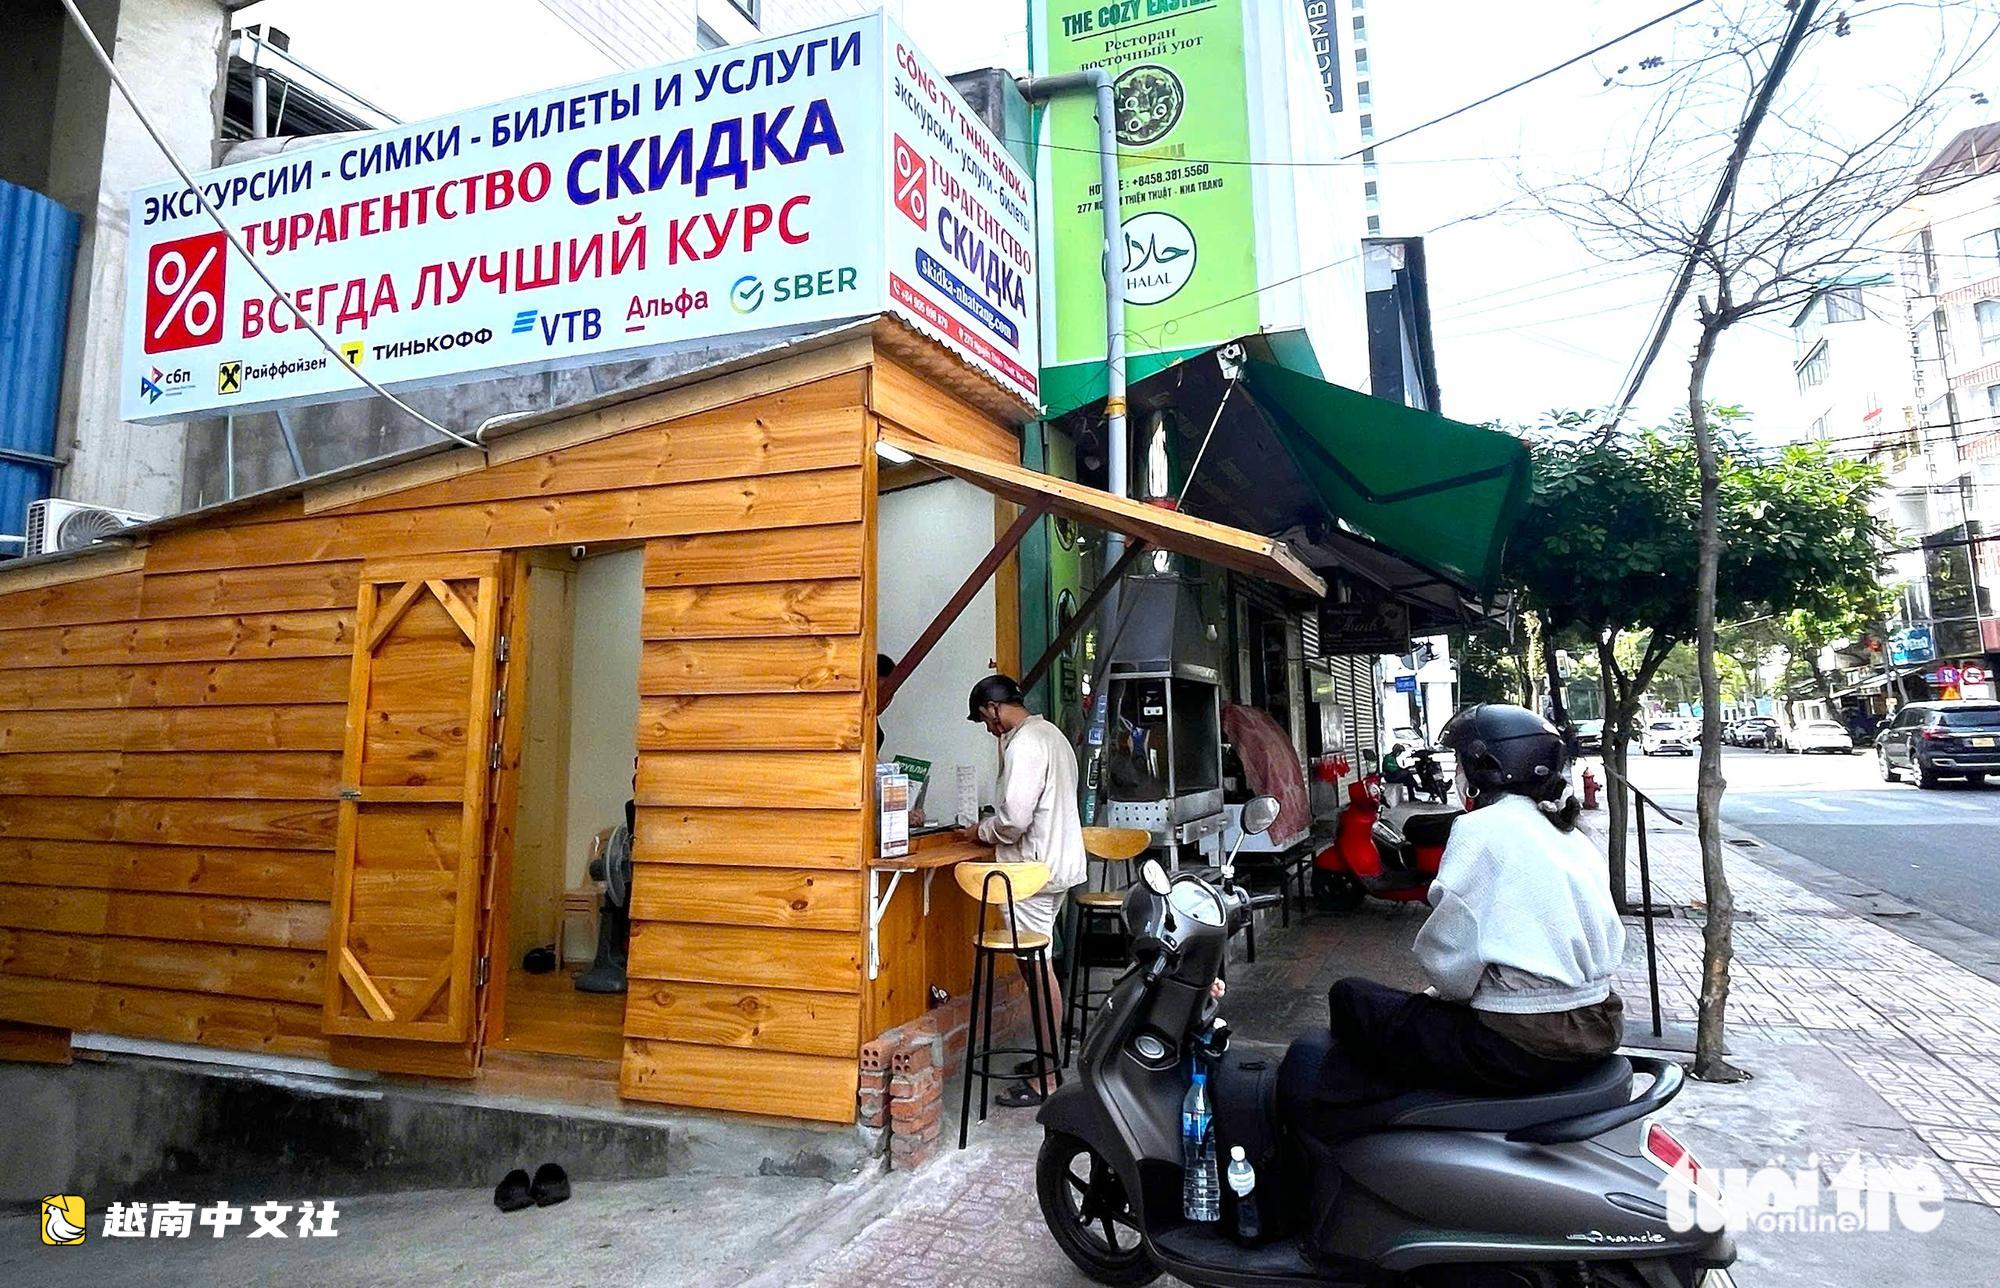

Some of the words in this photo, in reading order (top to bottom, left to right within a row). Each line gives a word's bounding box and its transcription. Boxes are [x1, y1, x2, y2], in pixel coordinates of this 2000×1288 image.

[1062, 11, 1093, 36] THE
[1098, 0, 1140, 27] COZY
[1079, 41, 1167, 71] восточный
[1171, 36, 1204, 55] уют
[1104, 27, 1176, 52] Ресторан
[143, 162, 313, 225] ЭКСКУРСИИ
[340, 126, 460, 194] СИМКИ
[492, 83, 640, 147] БИЛЕТЫ
[655, 73, 682, 111] И
[695, 31, 861, 102] УСЛУГИ
[897, 43, 937, 104] CÔNG
[940, 91, 956, 123] TY
[959, 112, 990, 163] TNHH
[992, 151, 1028, 207] SKIDKA
[241, 162, 551, 257] ТУРАГЕНТСТВО
[566, 98, 844, 205] СКИДКА
[961, 149, 993, 194] услуги
[1000, 186, 1030, 234] билеты
[1132, 163, 1209, 187] +8458.381.5560
[1077, 202, 1092, 214] 277
[1180, 182, 1196, 194] NHA
[1198, 178, 1224, 191] TRANG
[929, 155, 1031, 275] ТУРАГЕНТСТВО
[242, 273, 399, 339] ВСЕГДА
[411, 212, 647, 311] ЛУЧШИЙ
[668, 195, 811, 265] КУРС
[938, 206, 1027, 319] СКИДКА
[774, 266, 858, 303] SBER
[921, 257, 1012, 340] skidka-nhatrang.com
[1127, 272, 1172, 290] HALAL
[626, 288, 709, 321] Альфа
[373, 328, 493, 360] ТИНЬКОФФ
[540, 308, 602, 346] VTB
[166, 368, 191, 384] сбп
[245, 356, 327, 380] Райффайзен
